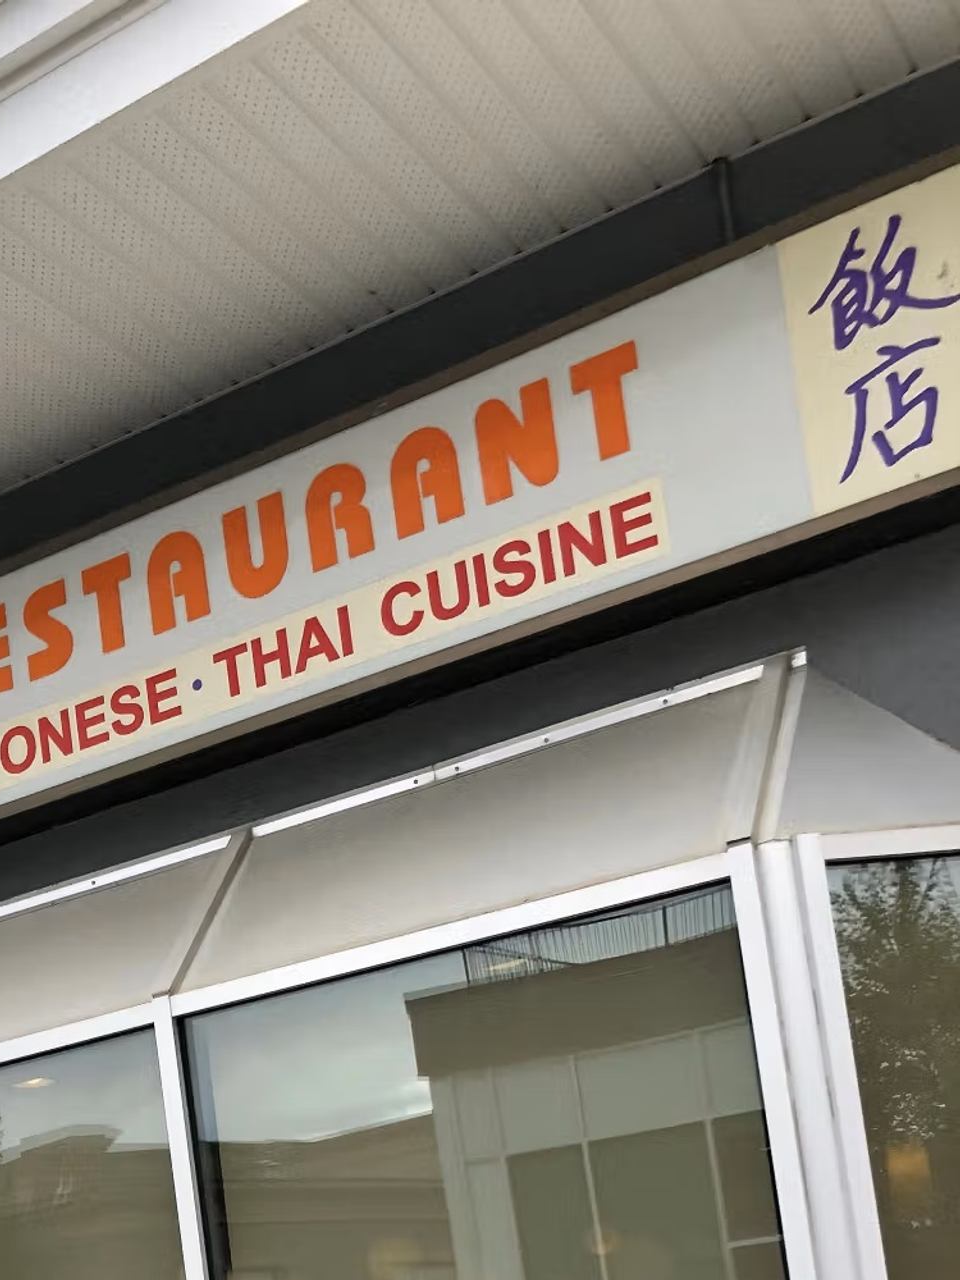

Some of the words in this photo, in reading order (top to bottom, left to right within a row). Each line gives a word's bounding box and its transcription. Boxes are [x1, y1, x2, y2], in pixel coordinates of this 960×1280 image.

[808, 214, 960, 484] 飯店
[212, 604, 356, 699] THAI
[380, 491, 660, 636] CUISINE
